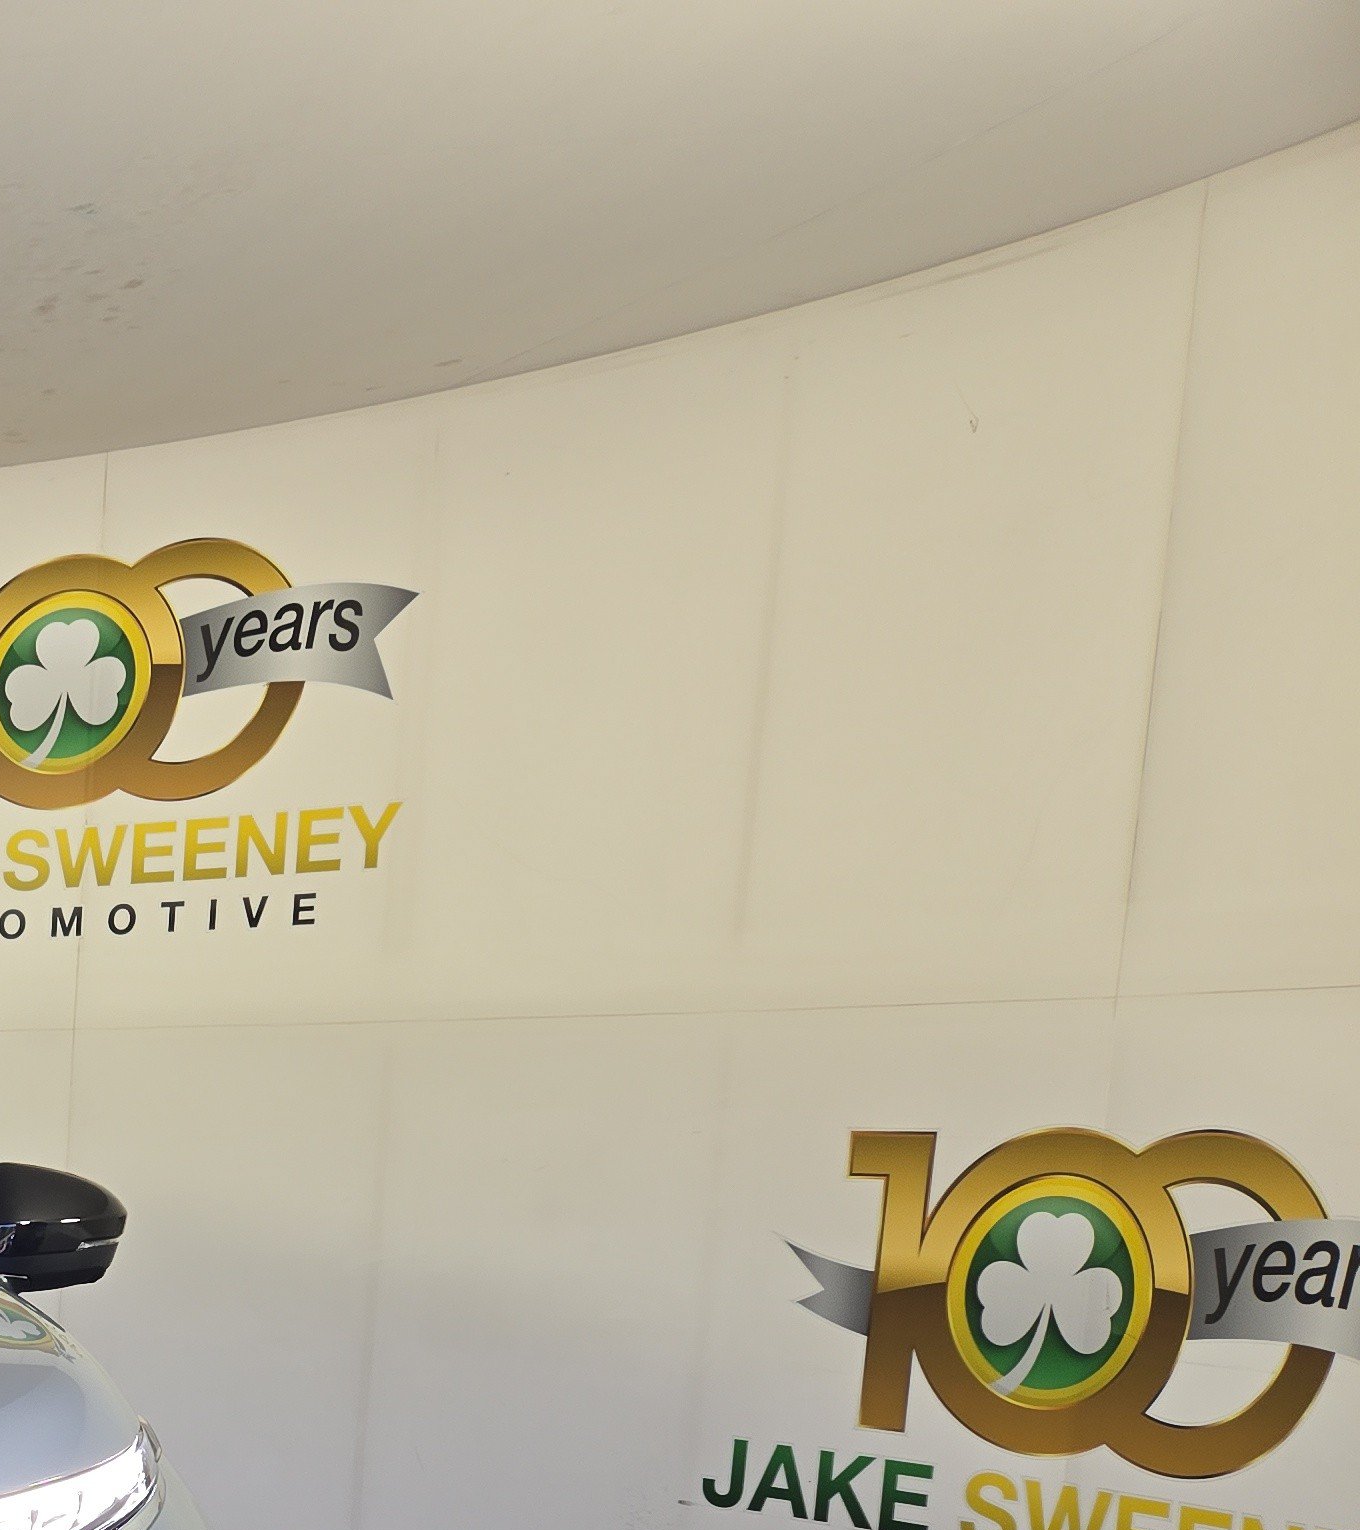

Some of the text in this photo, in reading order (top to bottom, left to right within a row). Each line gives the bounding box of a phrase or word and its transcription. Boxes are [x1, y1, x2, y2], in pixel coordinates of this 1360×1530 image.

[195, 594, 364, 683] years
[2, 801, 404, 892] SWEENEY
[1204, 1240, 1360, 1325] year
